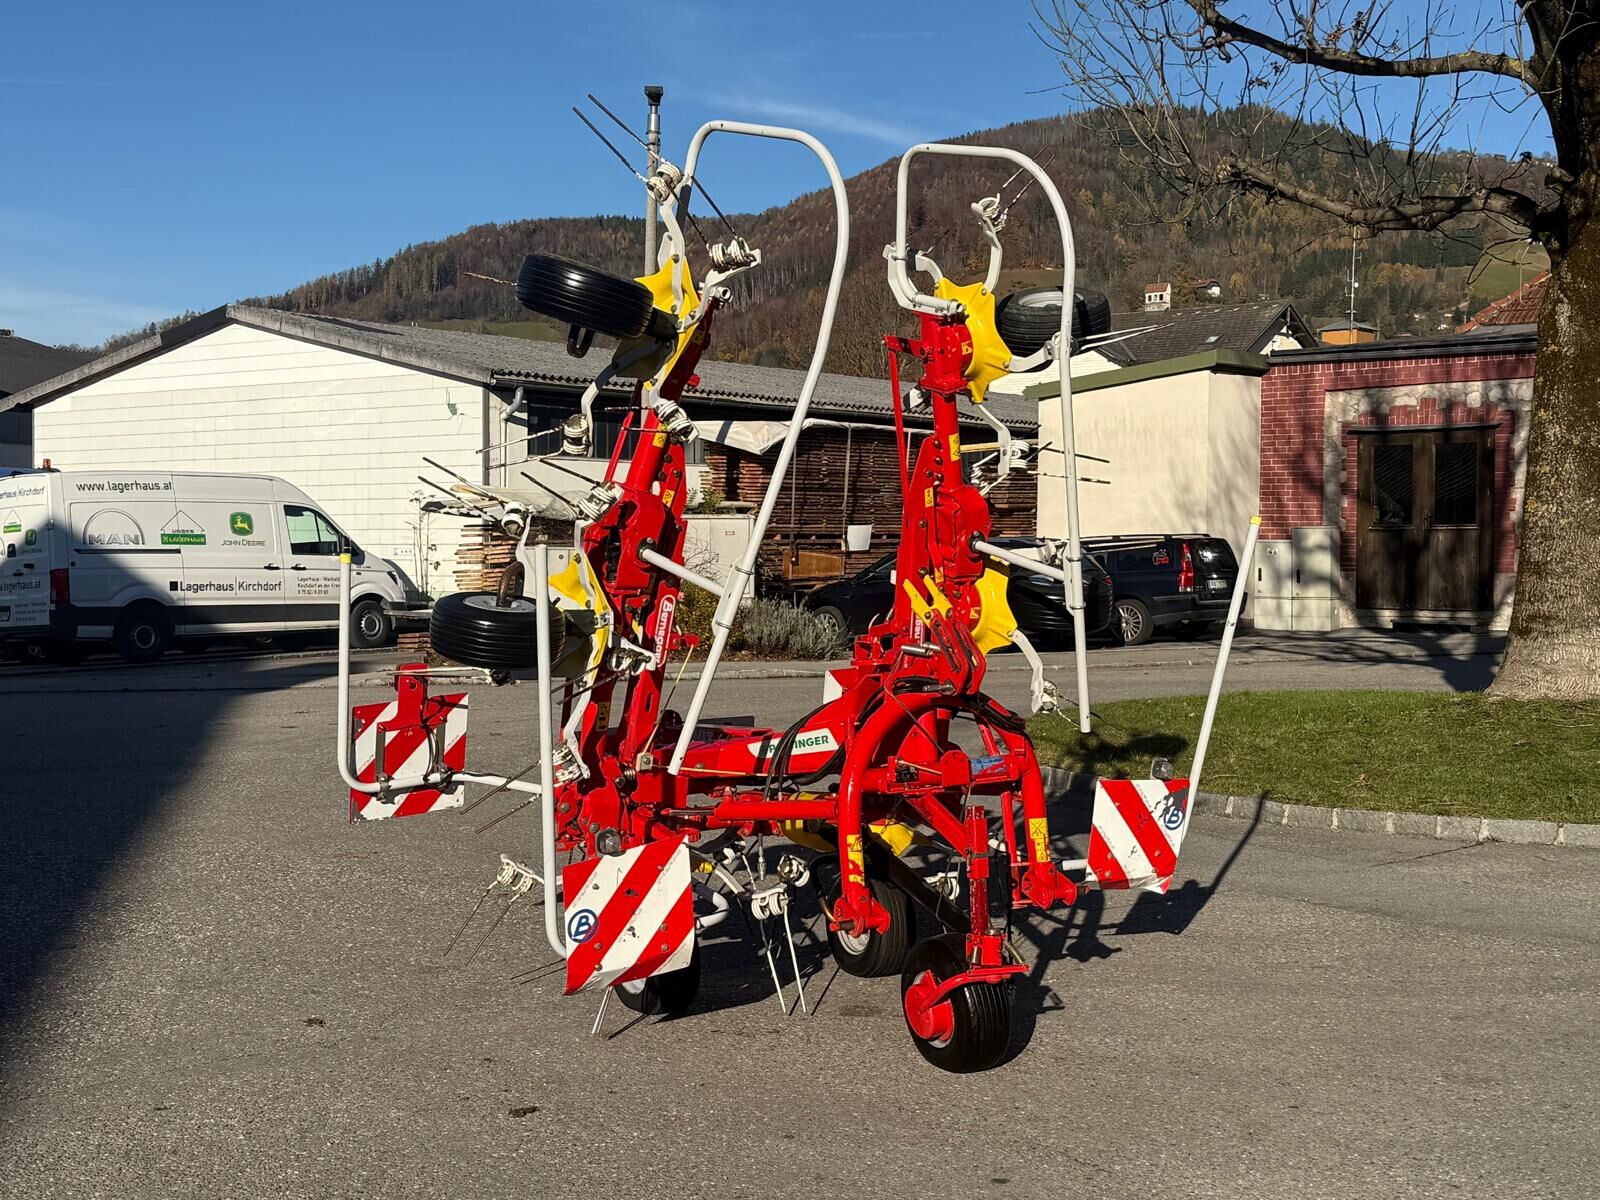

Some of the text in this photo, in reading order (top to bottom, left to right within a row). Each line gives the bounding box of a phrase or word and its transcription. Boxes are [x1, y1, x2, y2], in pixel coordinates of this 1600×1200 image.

[76, 480, 172, 493] www.lagerhaus.at
[88, 534, 140, 545] MAN
[241, 538, 267, 546] DEERE
[180, 581, 282, 594] Lagerhaus Kirchdorf
[769, 735, 830, 754] PINGER
